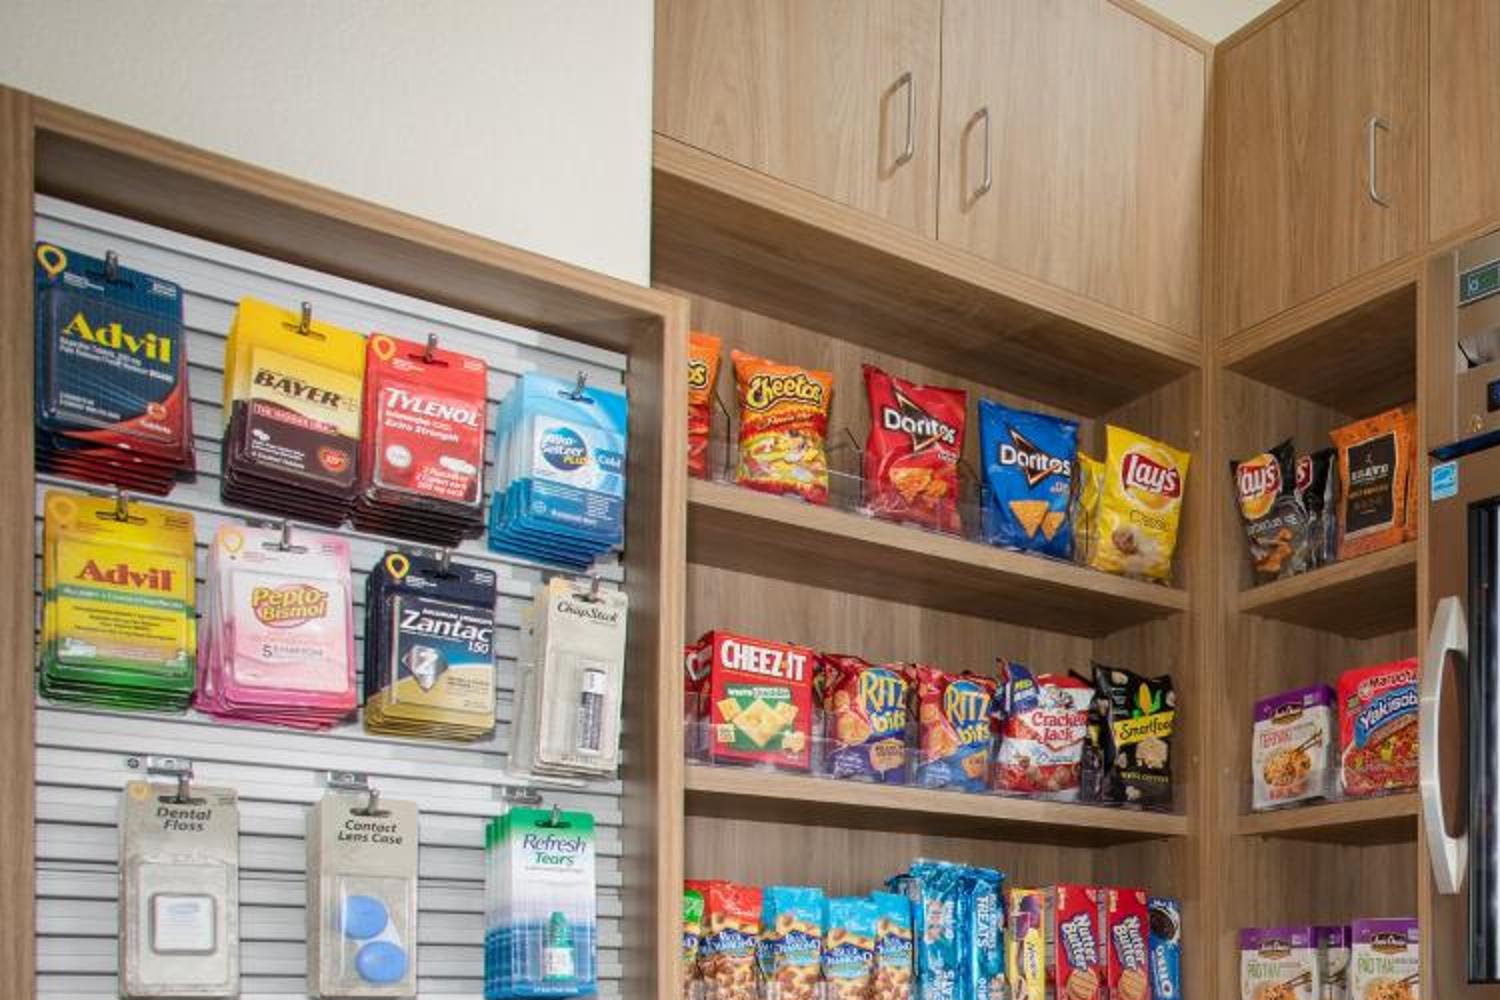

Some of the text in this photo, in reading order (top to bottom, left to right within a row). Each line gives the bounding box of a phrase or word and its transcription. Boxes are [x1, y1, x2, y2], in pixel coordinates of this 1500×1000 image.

[62, 311, 171, 364] Advil
[254, 370, 341, 408] BAYER
[747, 373, 824, 409] Cheetos
[384, 386, 480, 428] TYLENOL
[882, 406, 957, 445] Doritos
[999, 443, 1072, 476] Doritos
[1126, 453, 1178, 493] Lay's
[76, 559, 176, 592] Advil
[251, 586, 329, 608] Pepto-
[258, 603, 328, 623] Bismol
[400, 609, 494, 643] Zantac
[858, 668, 909, 711] RITZ
[944, 687, 991, 721] RITZ
[1031, 711, 1089, 728] Cracker
[1360, 690, 1418, 730] Yakisob
[1038, 727, 1074, 746] Jack
[156, 806, 212, 821] Dental
[163, 817, 205, 832] Floss
[344, 818, 397, 833] Contact
[338, 830, 403, 845] Lens Case
[522, 832, 588, 853] Refresh
[534, 850, 575, 866] Tears
[1061, 922, 1088, 971] Butter
[1072, 914, 1097, 964] Nutter
[1112, 922, 1138, 971] Butter
[1122, 915, 1147, 964] Nutter
